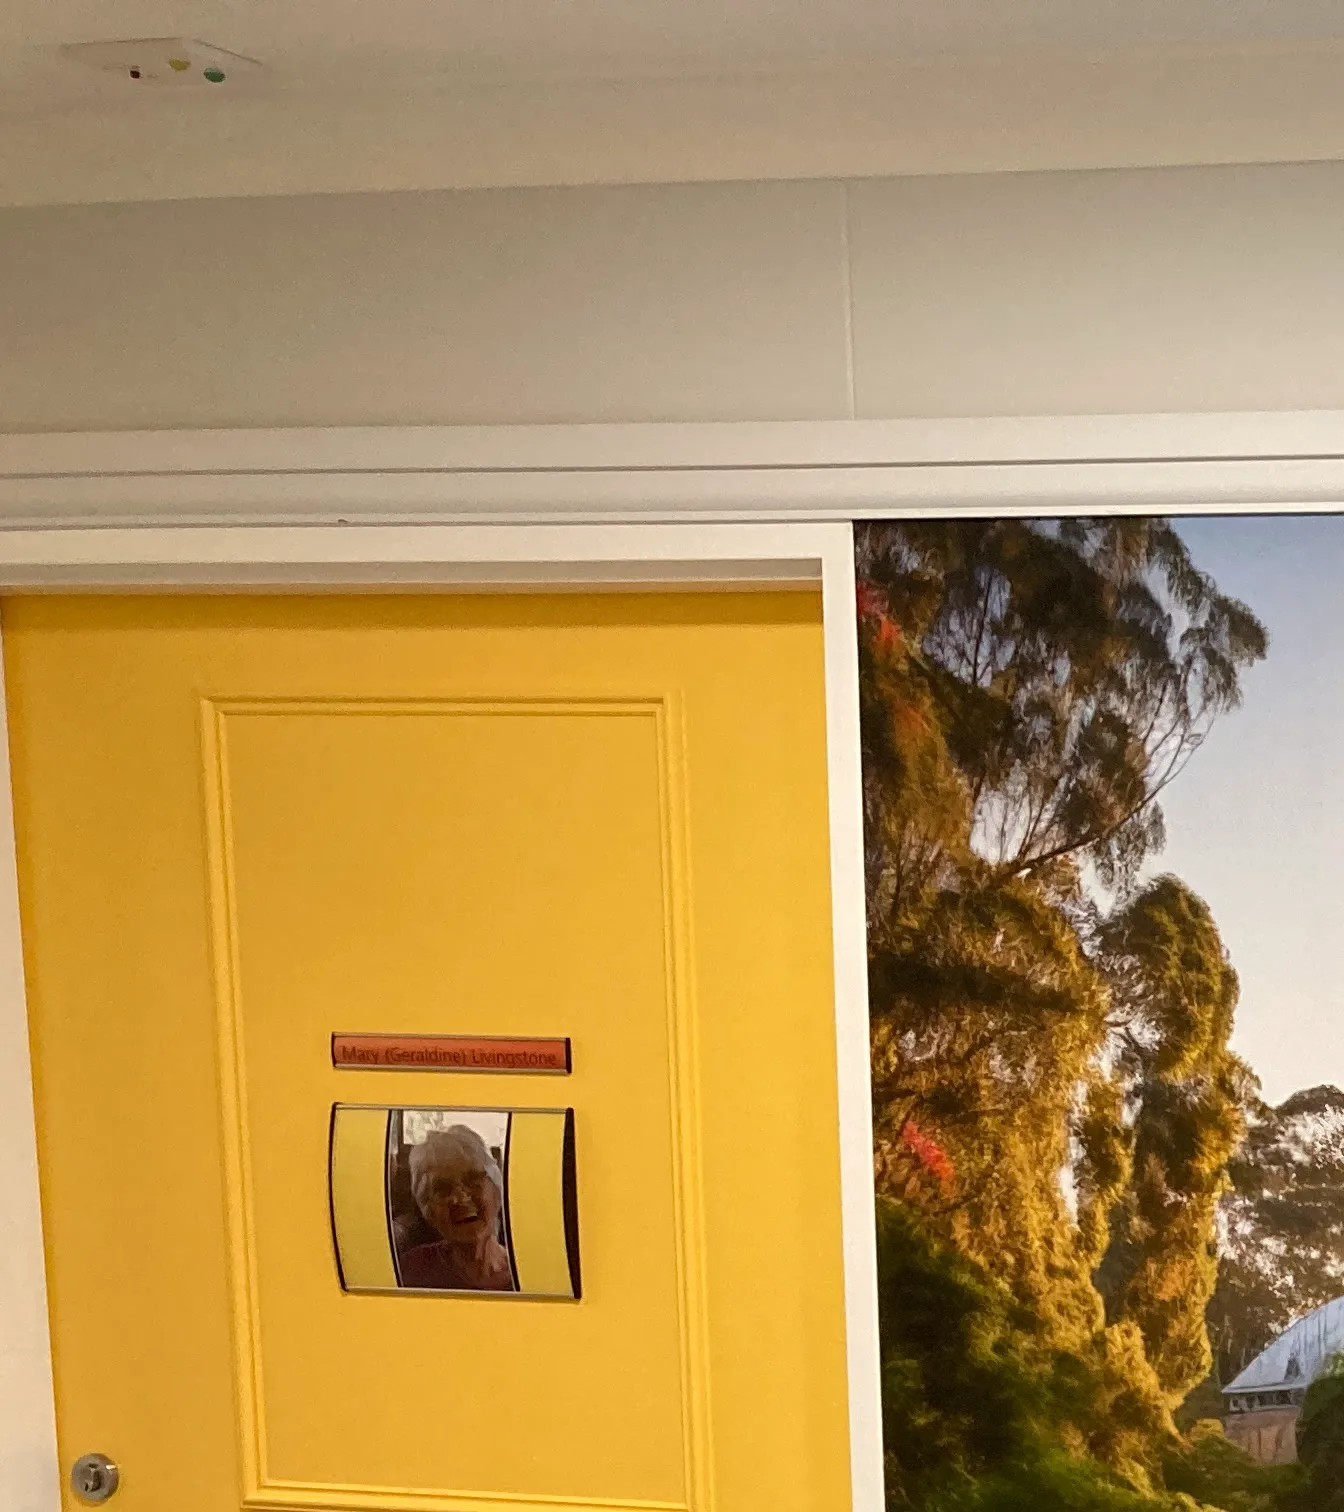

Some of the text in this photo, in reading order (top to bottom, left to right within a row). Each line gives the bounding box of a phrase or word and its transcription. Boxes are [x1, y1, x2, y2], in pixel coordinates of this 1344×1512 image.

[342, 1045, 557, 1067] Mary (Geraldine) Livingstone
